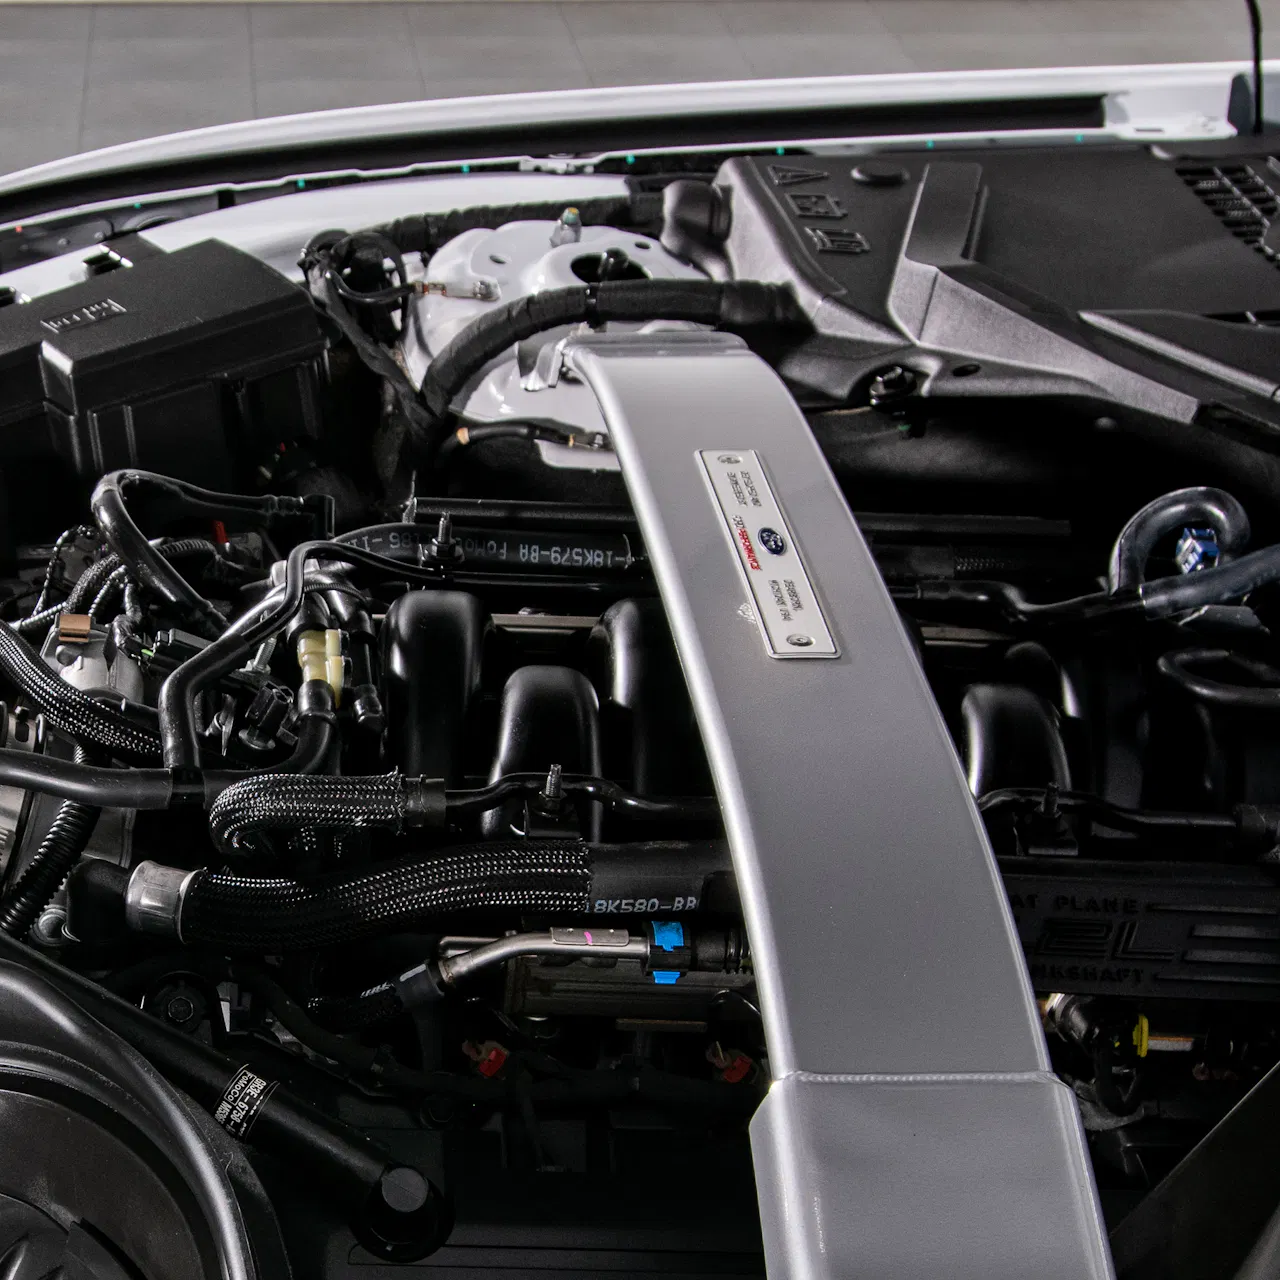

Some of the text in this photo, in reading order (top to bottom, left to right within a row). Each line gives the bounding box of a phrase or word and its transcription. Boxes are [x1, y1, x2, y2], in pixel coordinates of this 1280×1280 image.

[454, 537, 508, 560] FoMoC
[738, 528, 762, 571] PERFORMANCE
[227, 1071, 255, 1102] FoMoCo
